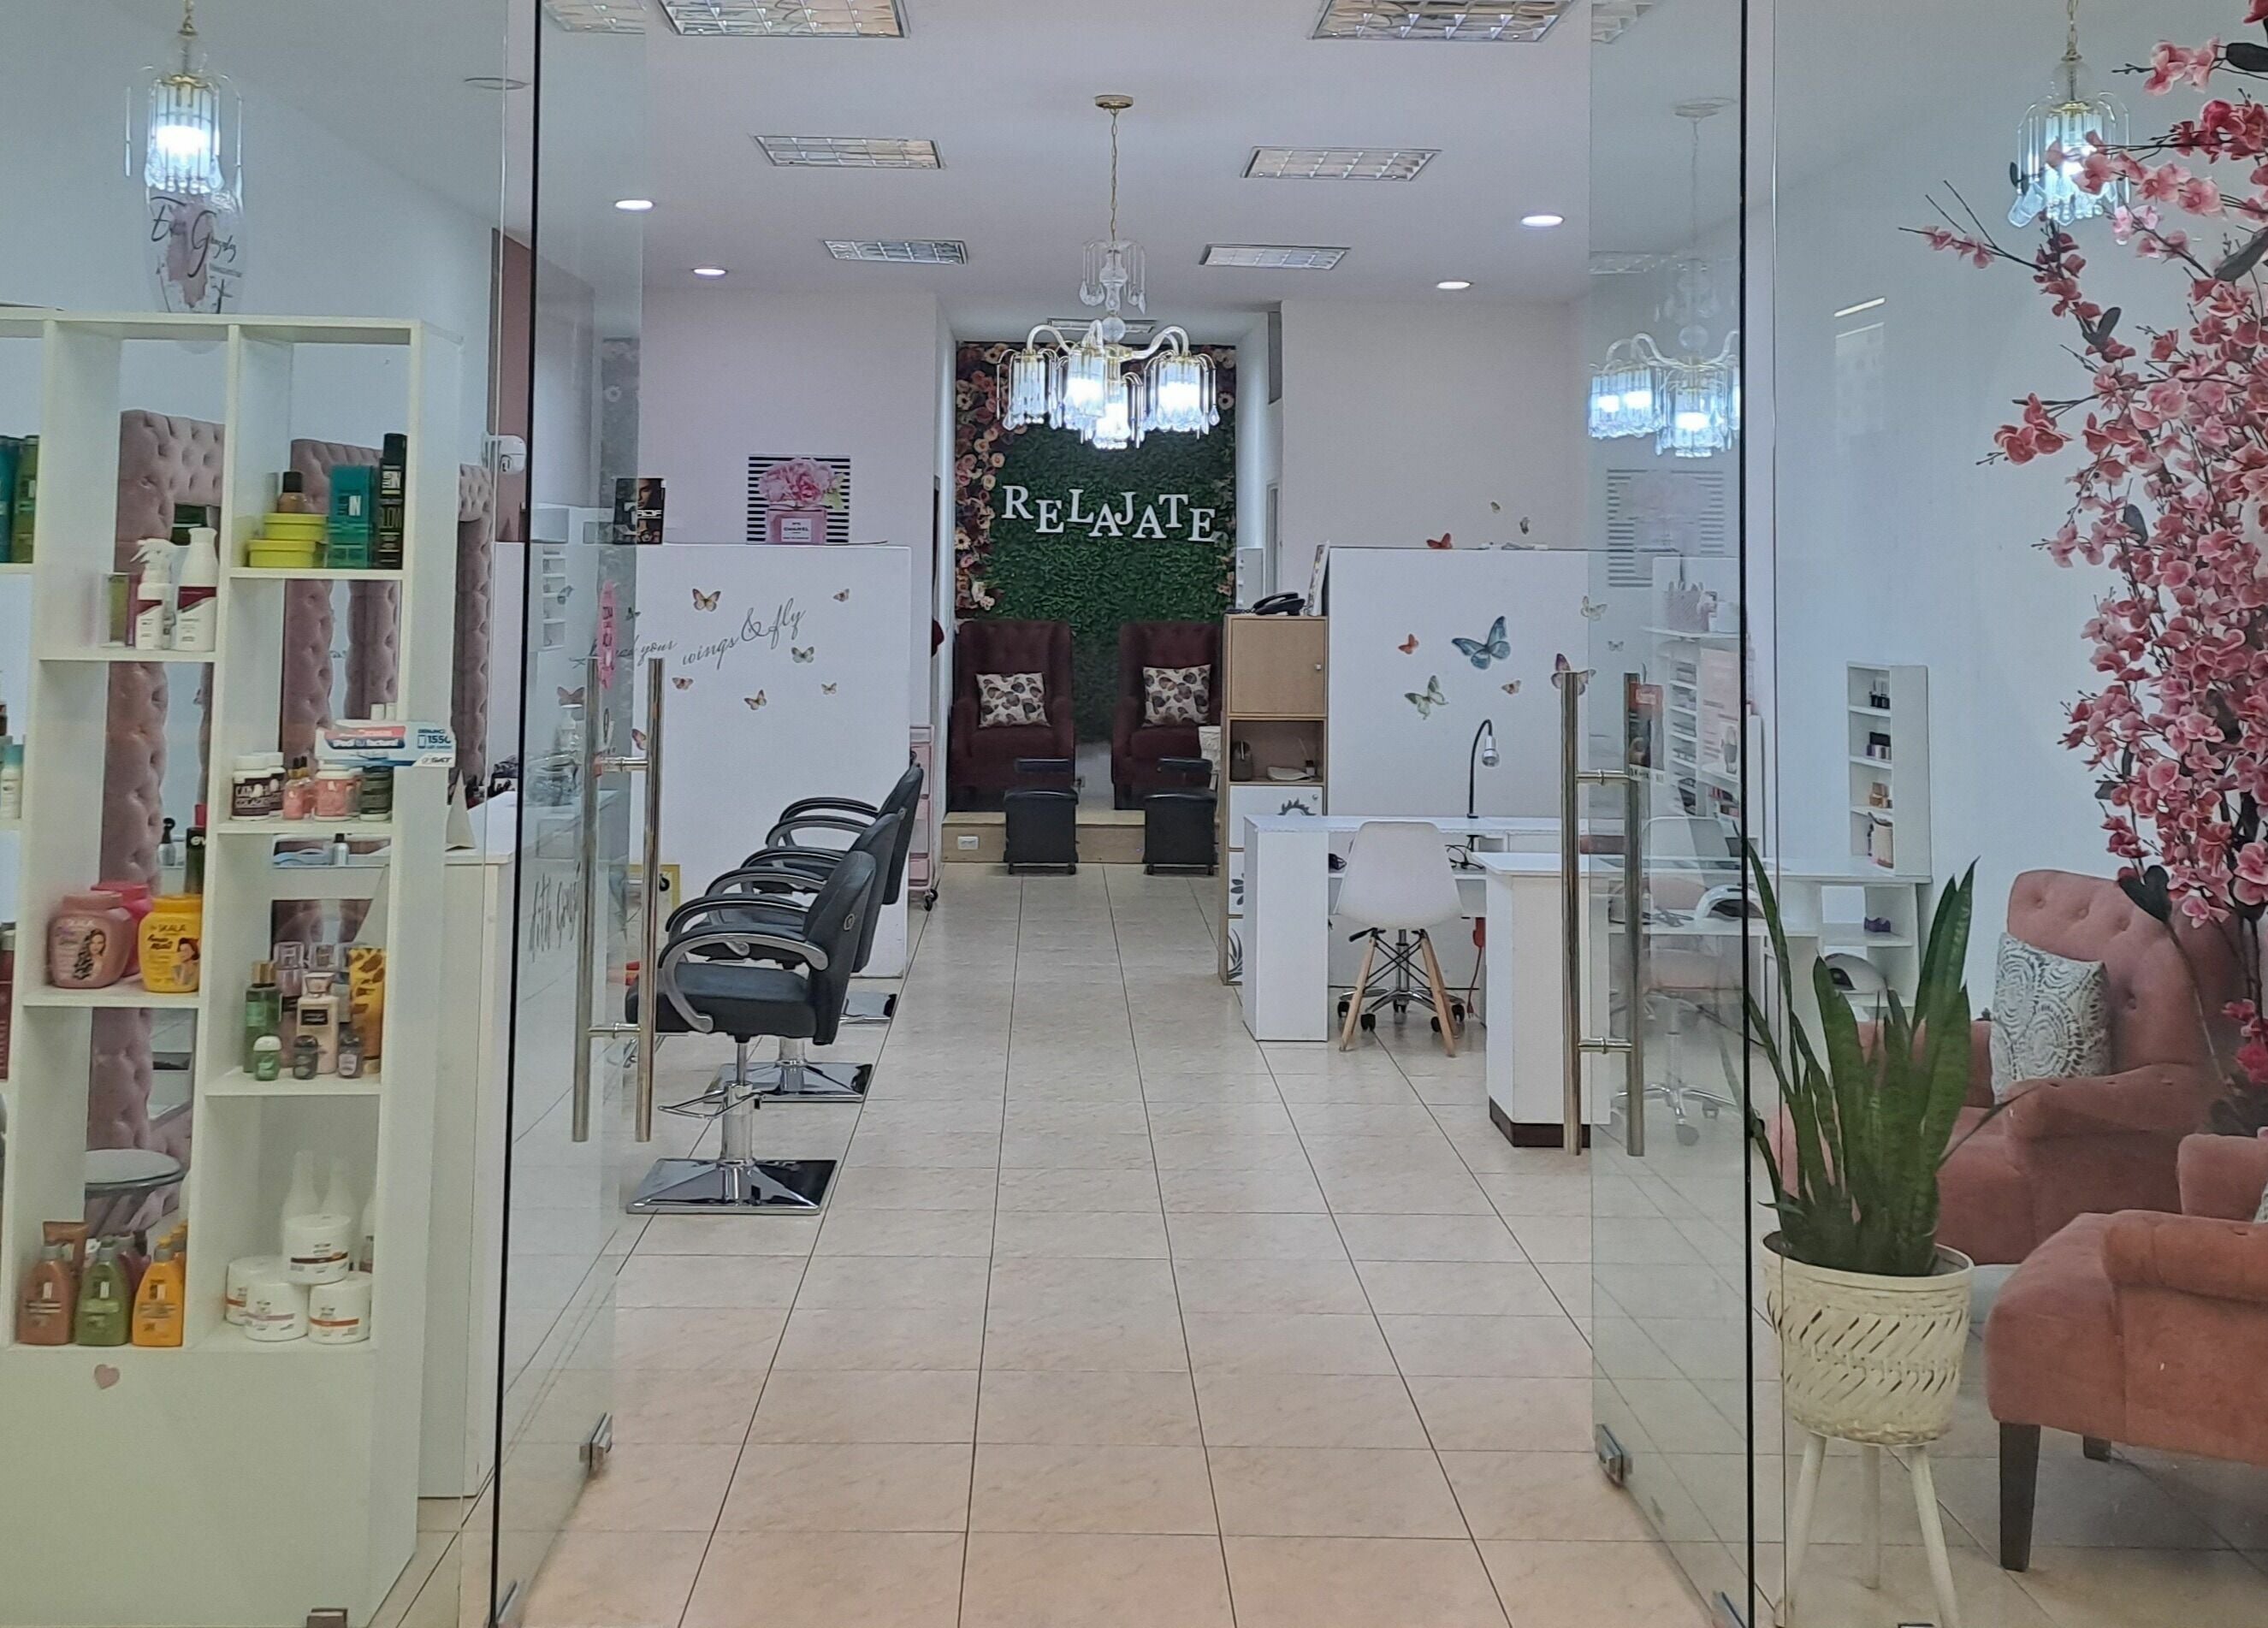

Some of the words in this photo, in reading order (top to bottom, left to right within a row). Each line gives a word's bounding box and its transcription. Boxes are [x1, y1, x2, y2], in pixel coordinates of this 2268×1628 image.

[1001, 485, 1216, 542] RELAJATE
[635, 639, 678, 666] your
[683, 634, 740, 671] wings
[741, 607, 769, 642] &
[766, 597, 807, 650] fly
